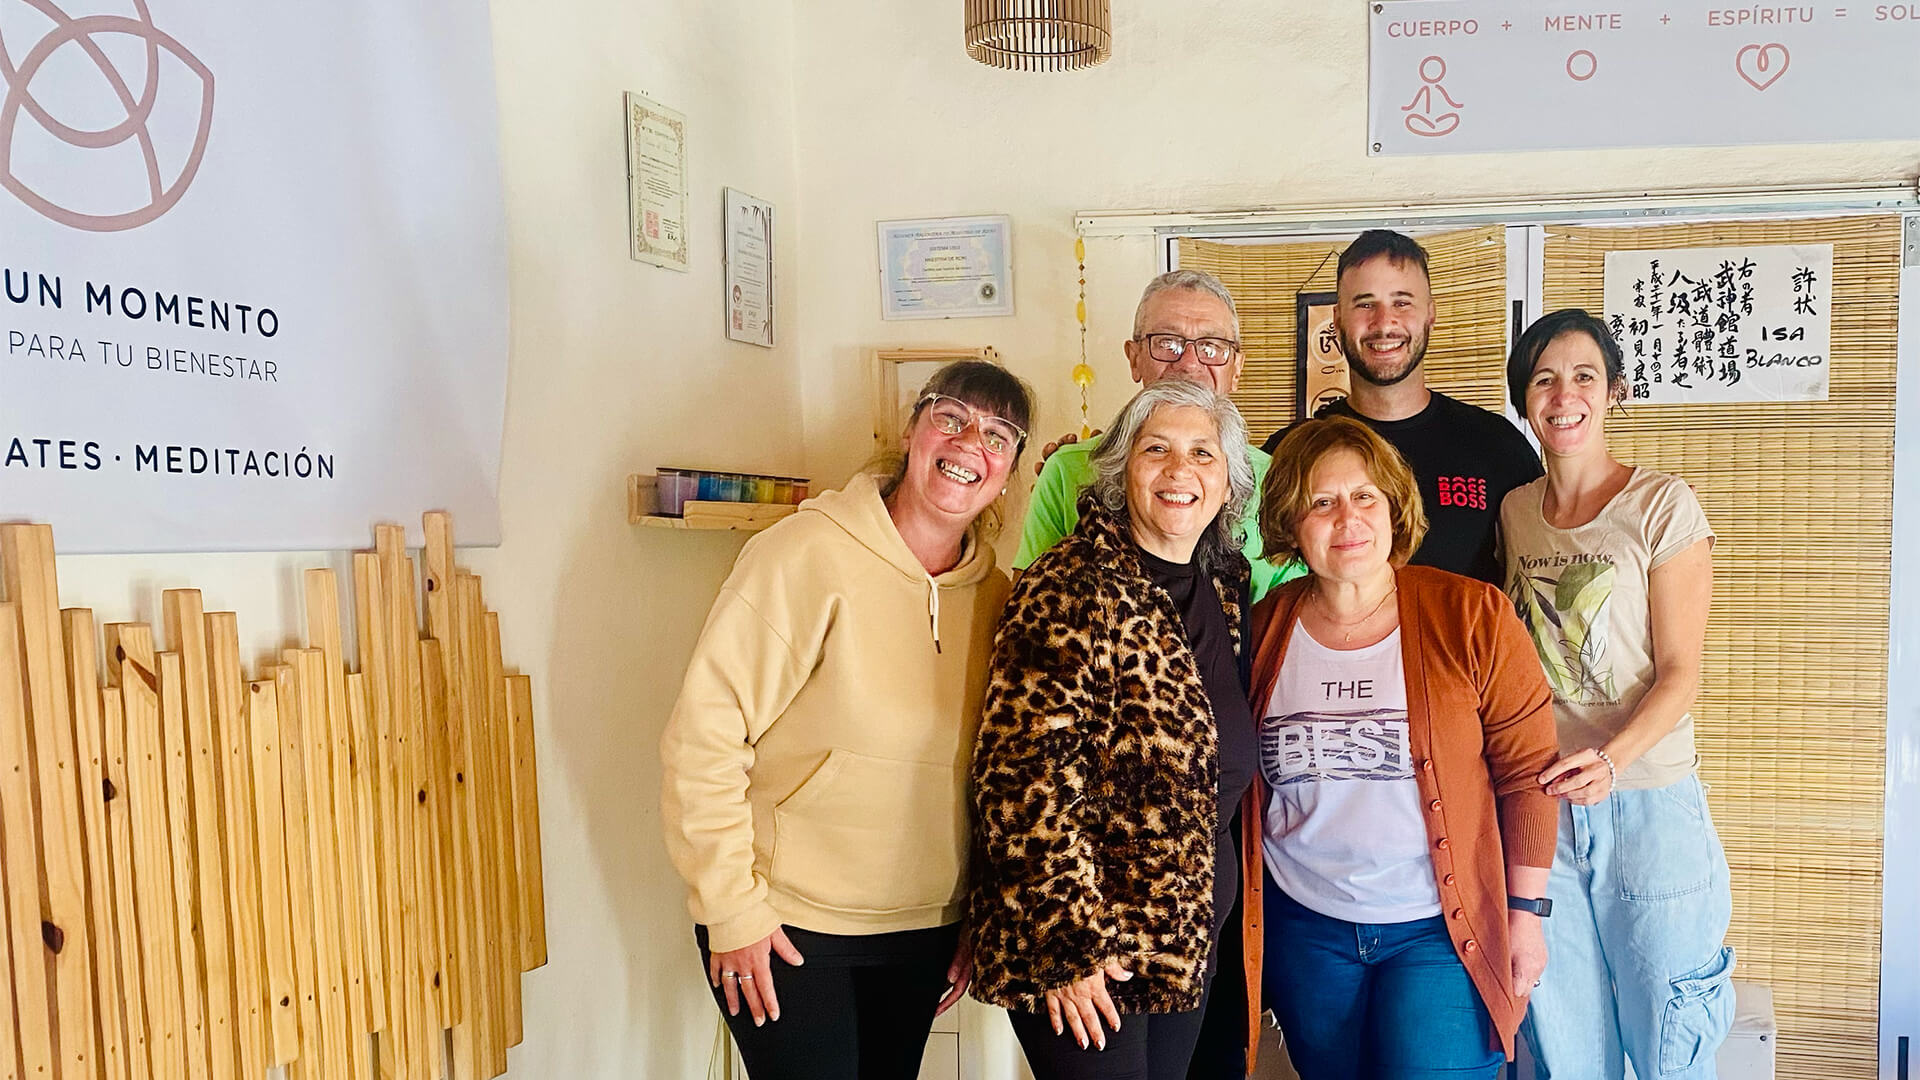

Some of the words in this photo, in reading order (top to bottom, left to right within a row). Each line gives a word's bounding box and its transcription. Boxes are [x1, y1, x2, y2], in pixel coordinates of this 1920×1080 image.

[1387, 19, 1479, 38] CUERPO
[1544, 14, 1622, 32] MENTE
[1708, 4, 1814, 26] ESPÍRITU
[1875, 4, 1920, 21] SOL
[5, 268, 62, 309] UN
[86, 281, 279, 338] MOMENTO
[1791, 266, 1817, 316] 許状
[1714, 260, 1741, 387] 武神館道場
[1762, 326, 1804, 341] ISA
[9, 330, 86, 362] PARA
[98, 341, 133, 367] TU
[147, 346, 277, 382] BIENESTAR
[1745, 348, 1822, 368] BLANCO
[5, 437, 101, 470] ATES
[136, 444, 334, 479] MEDITACIÓN
[1440, 491, 1487, 510] BOSS
[1518, 554, 1552, 571] Now
[1552, 552, 1568, 567] is
[1570, 551, 1615, 566] now.
[1321, 680, 1373, 700] THE
[1278, 720, 1412, 776] BEST
